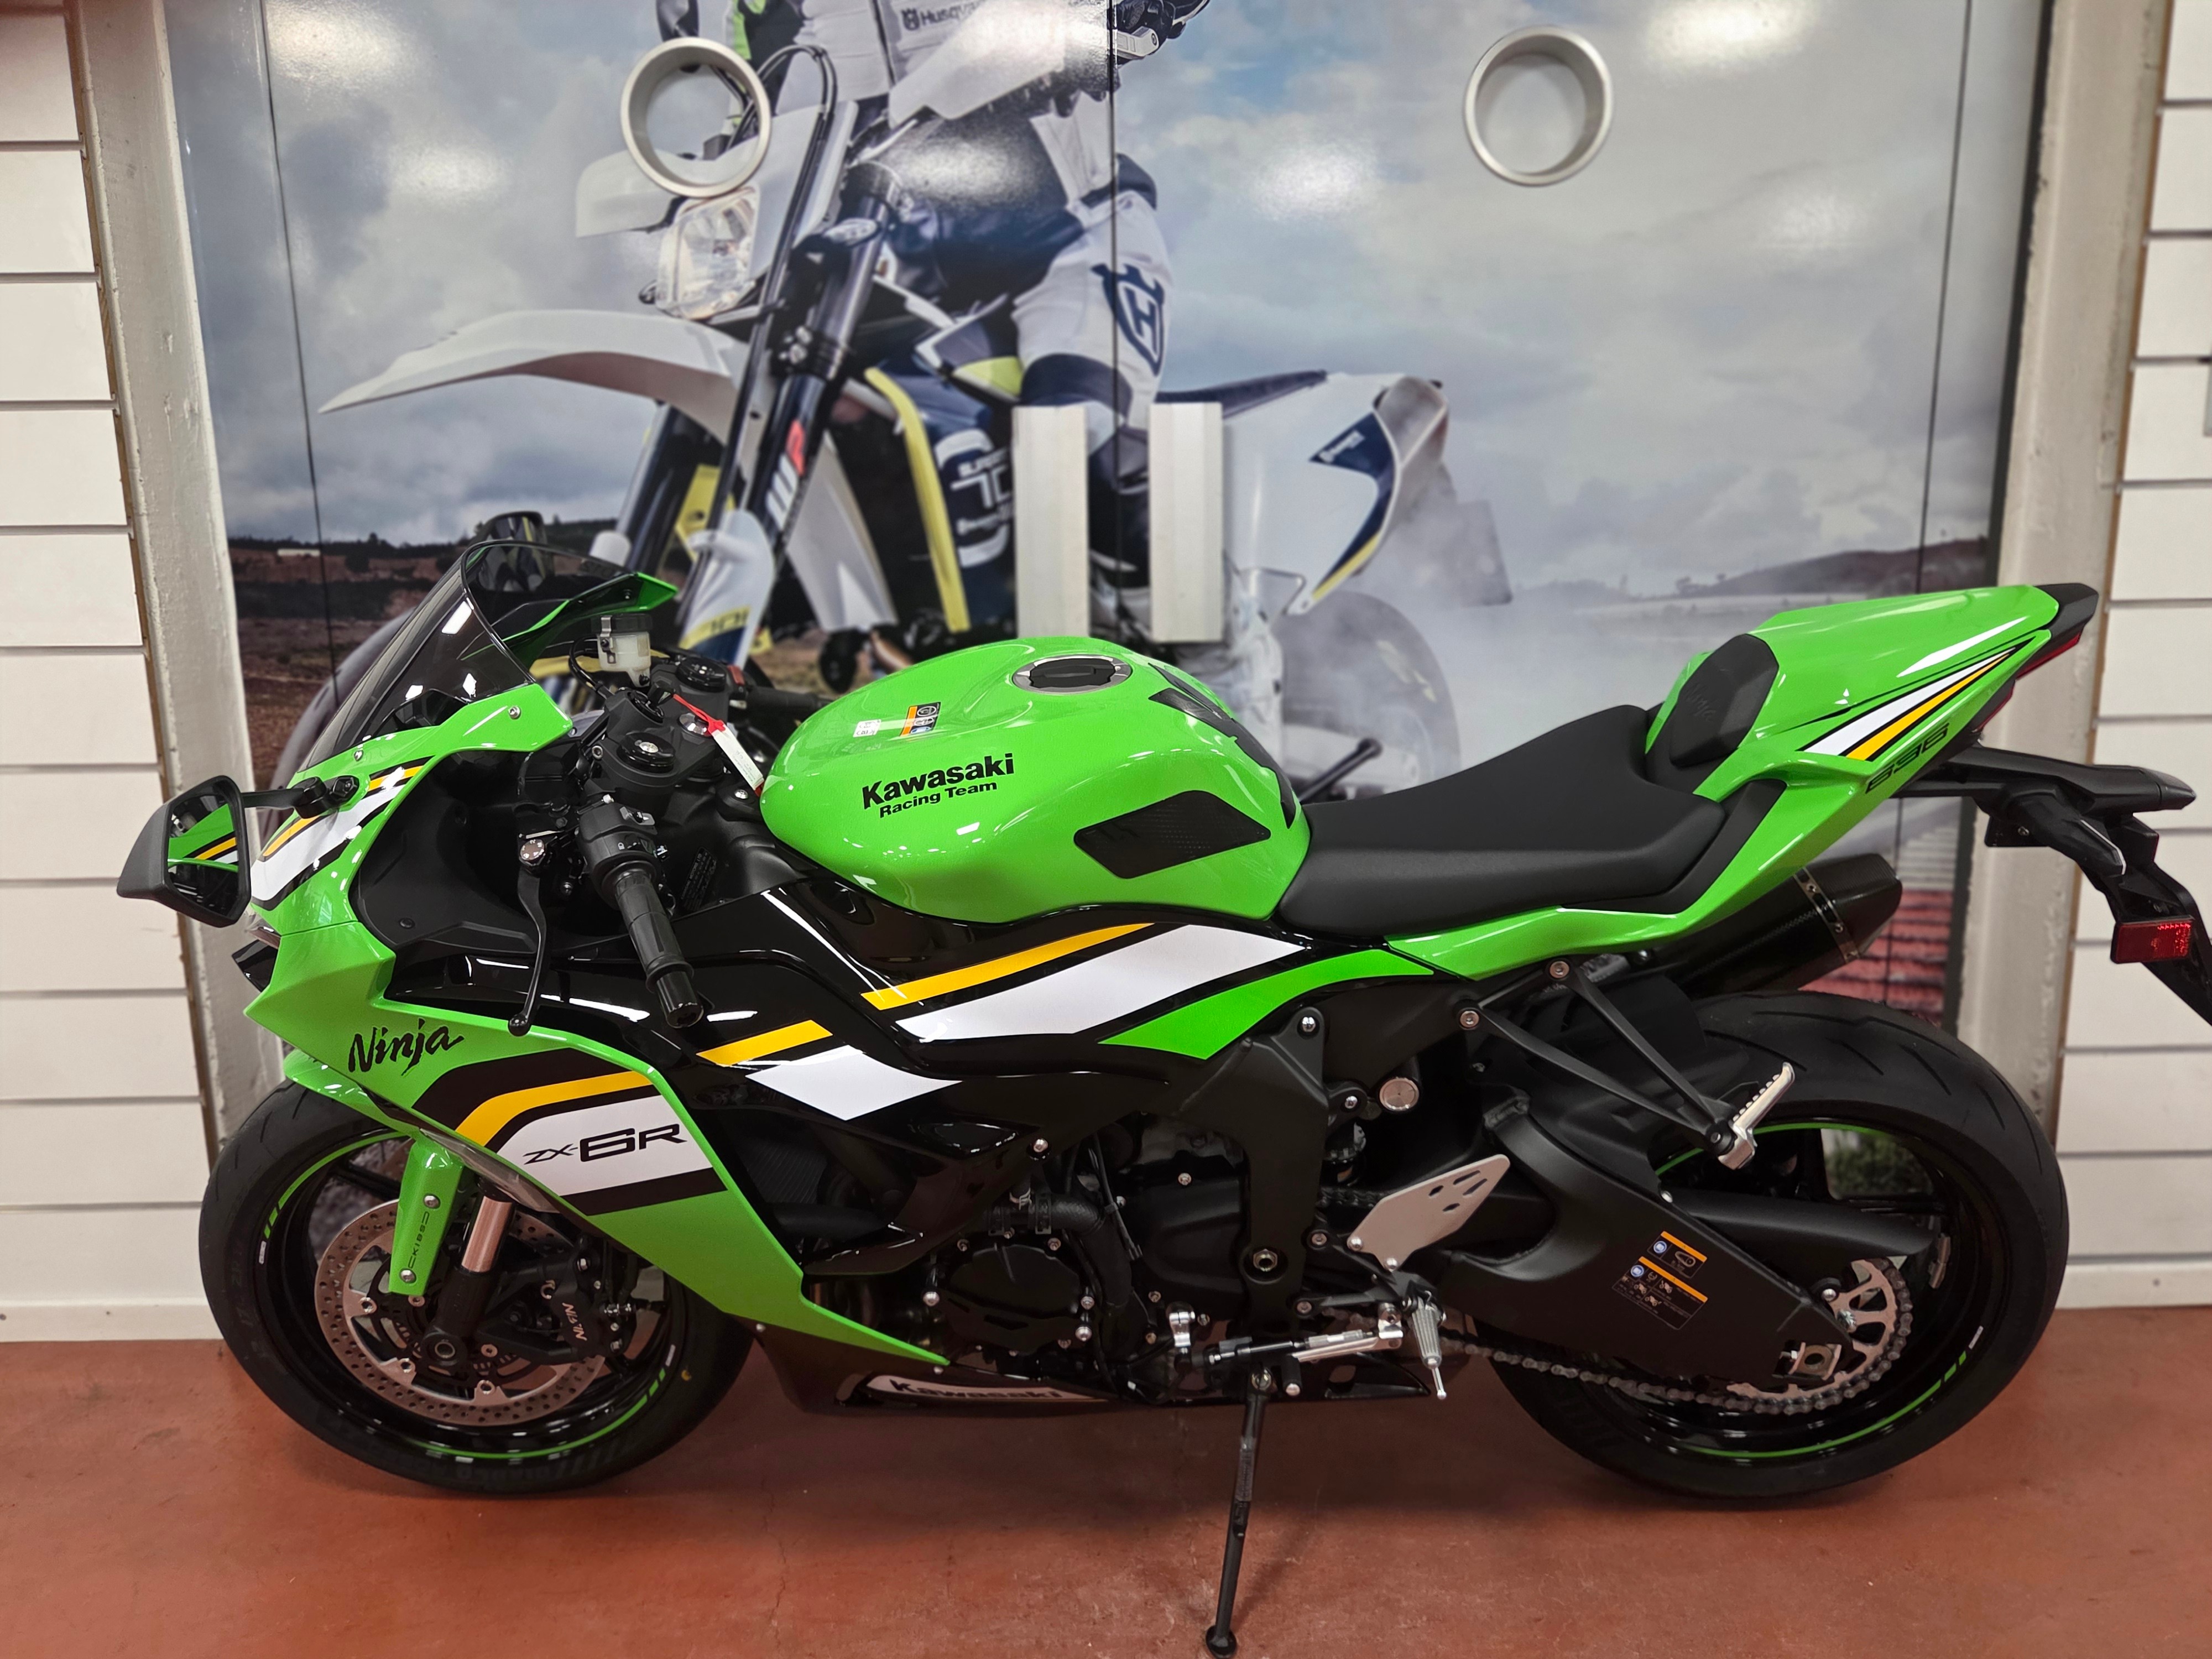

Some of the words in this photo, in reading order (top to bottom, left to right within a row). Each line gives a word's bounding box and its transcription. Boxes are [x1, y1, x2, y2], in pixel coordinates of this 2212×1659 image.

[920, 1, 982, 26] Husqva
[1865, 722, 1950, 795] 636
[862, 753, 1014, 810] Kawasaki
[880, 792, 941, 818] Racing
[945, 782, 998, 799] Team
[348, 1018, 465, 1076] Ninja
[523, 1124, 687, 1165] ZX-6R
[412, 1224, 425, 1256] KIBS
[889, 1378, 1063, 1399] Kawasaki
